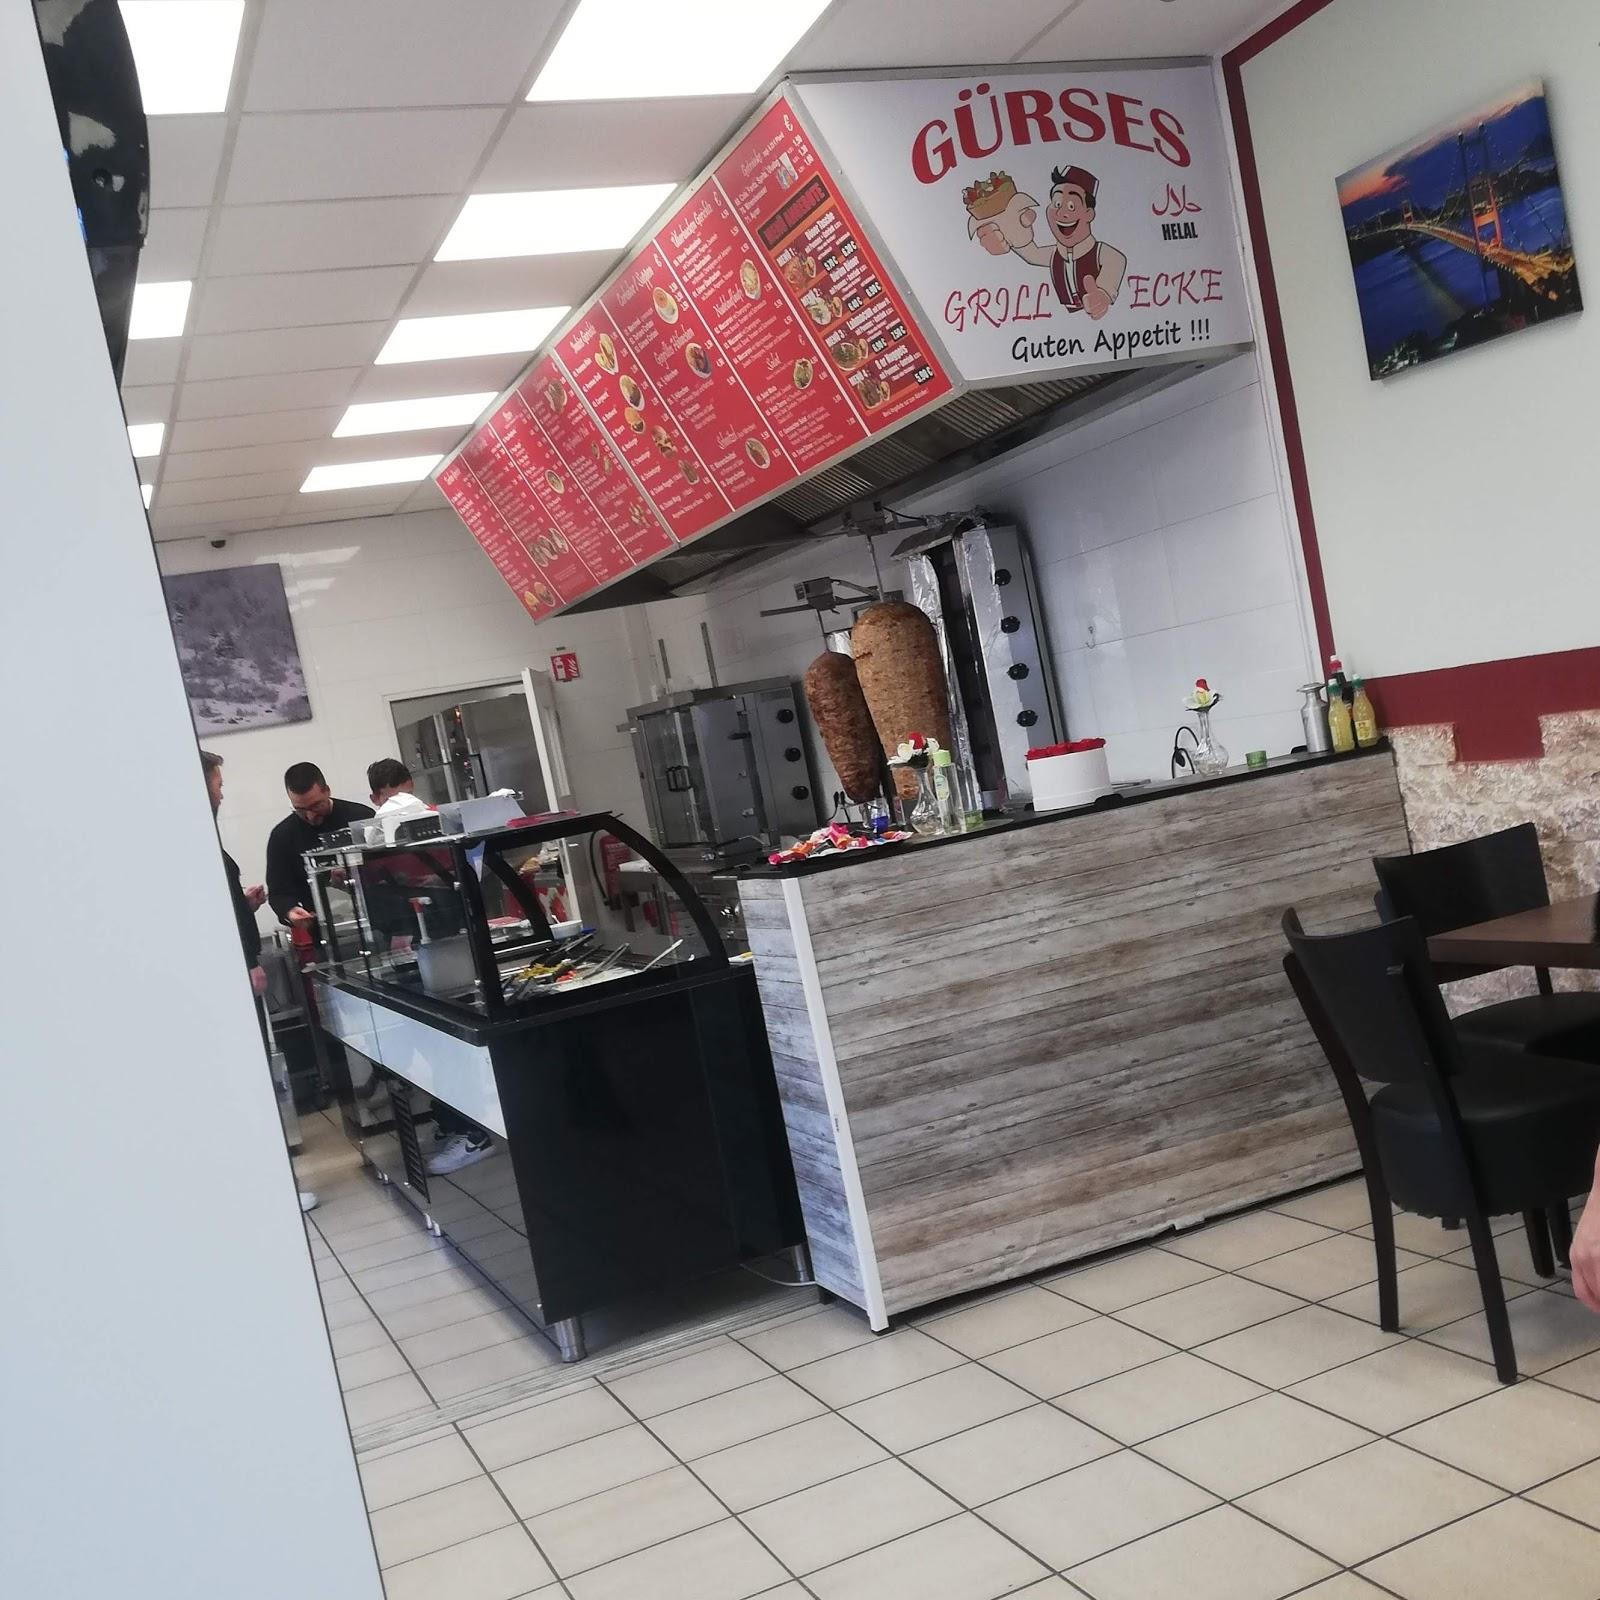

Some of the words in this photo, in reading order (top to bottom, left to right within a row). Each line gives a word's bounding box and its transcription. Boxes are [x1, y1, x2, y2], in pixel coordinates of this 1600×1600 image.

[911, 82, 1191, 184] GÜRSES
[1162, 222, 1198, 241] HELAL
[945, 283, 1053, 332] GRILL
[1127, 269, 1224, 309] ECKE
[1011, 335, 1085, 362] Guten
[1093, 321, 1182, 360] Appetit
[1190, 318, 1211, 342] !!!
